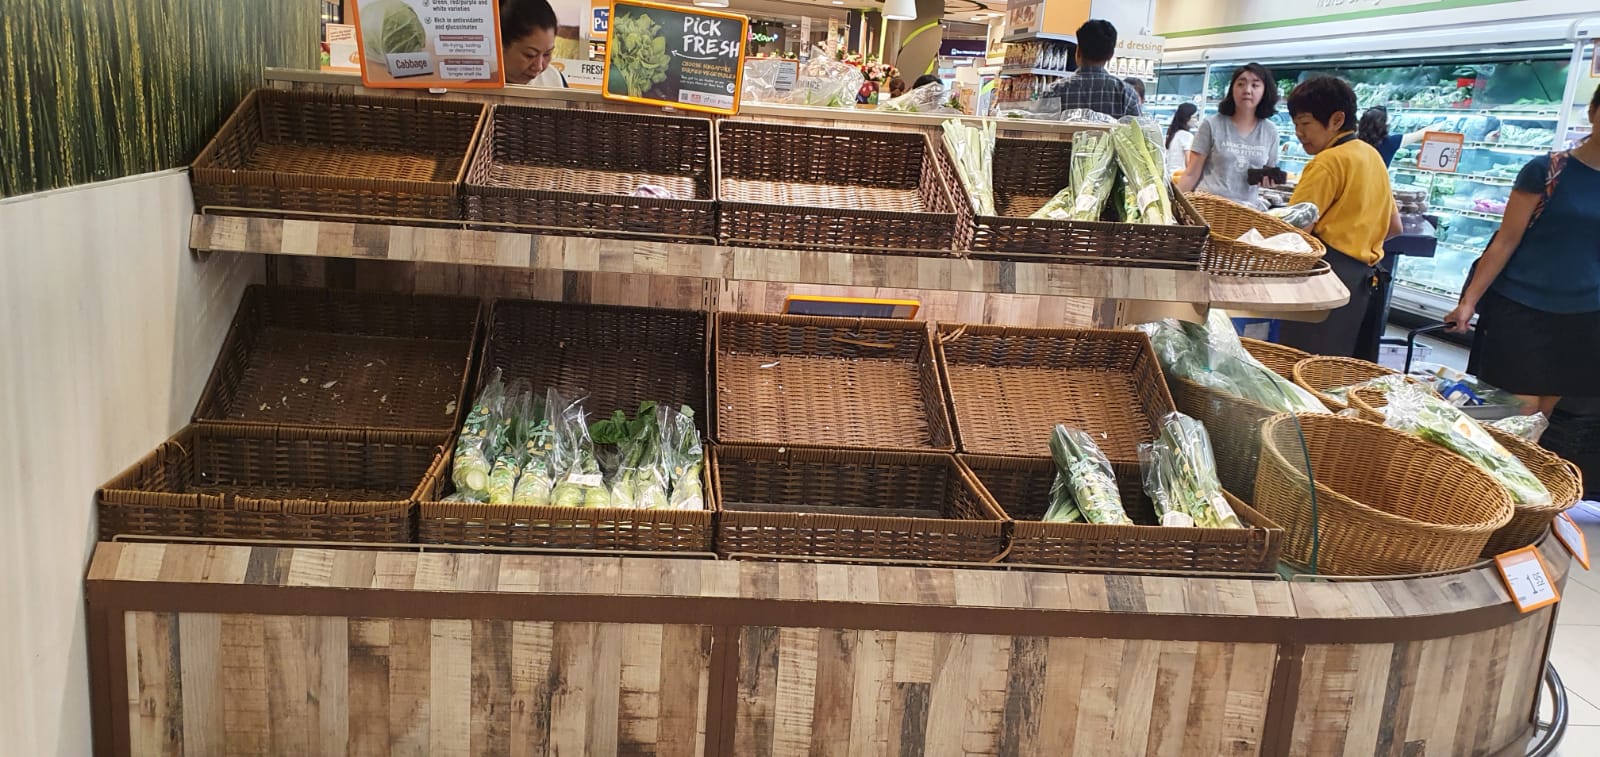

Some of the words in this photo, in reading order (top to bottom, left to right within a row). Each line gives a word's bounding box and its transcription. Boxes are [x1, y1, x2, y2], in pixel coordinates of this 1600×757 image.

[682, 34, 740, 58] FRESH
[1126, 40, 1164, 53] dressing
[395, 59, 428, 69] Cabbage
[1438, 147, 1450, 167] 6
